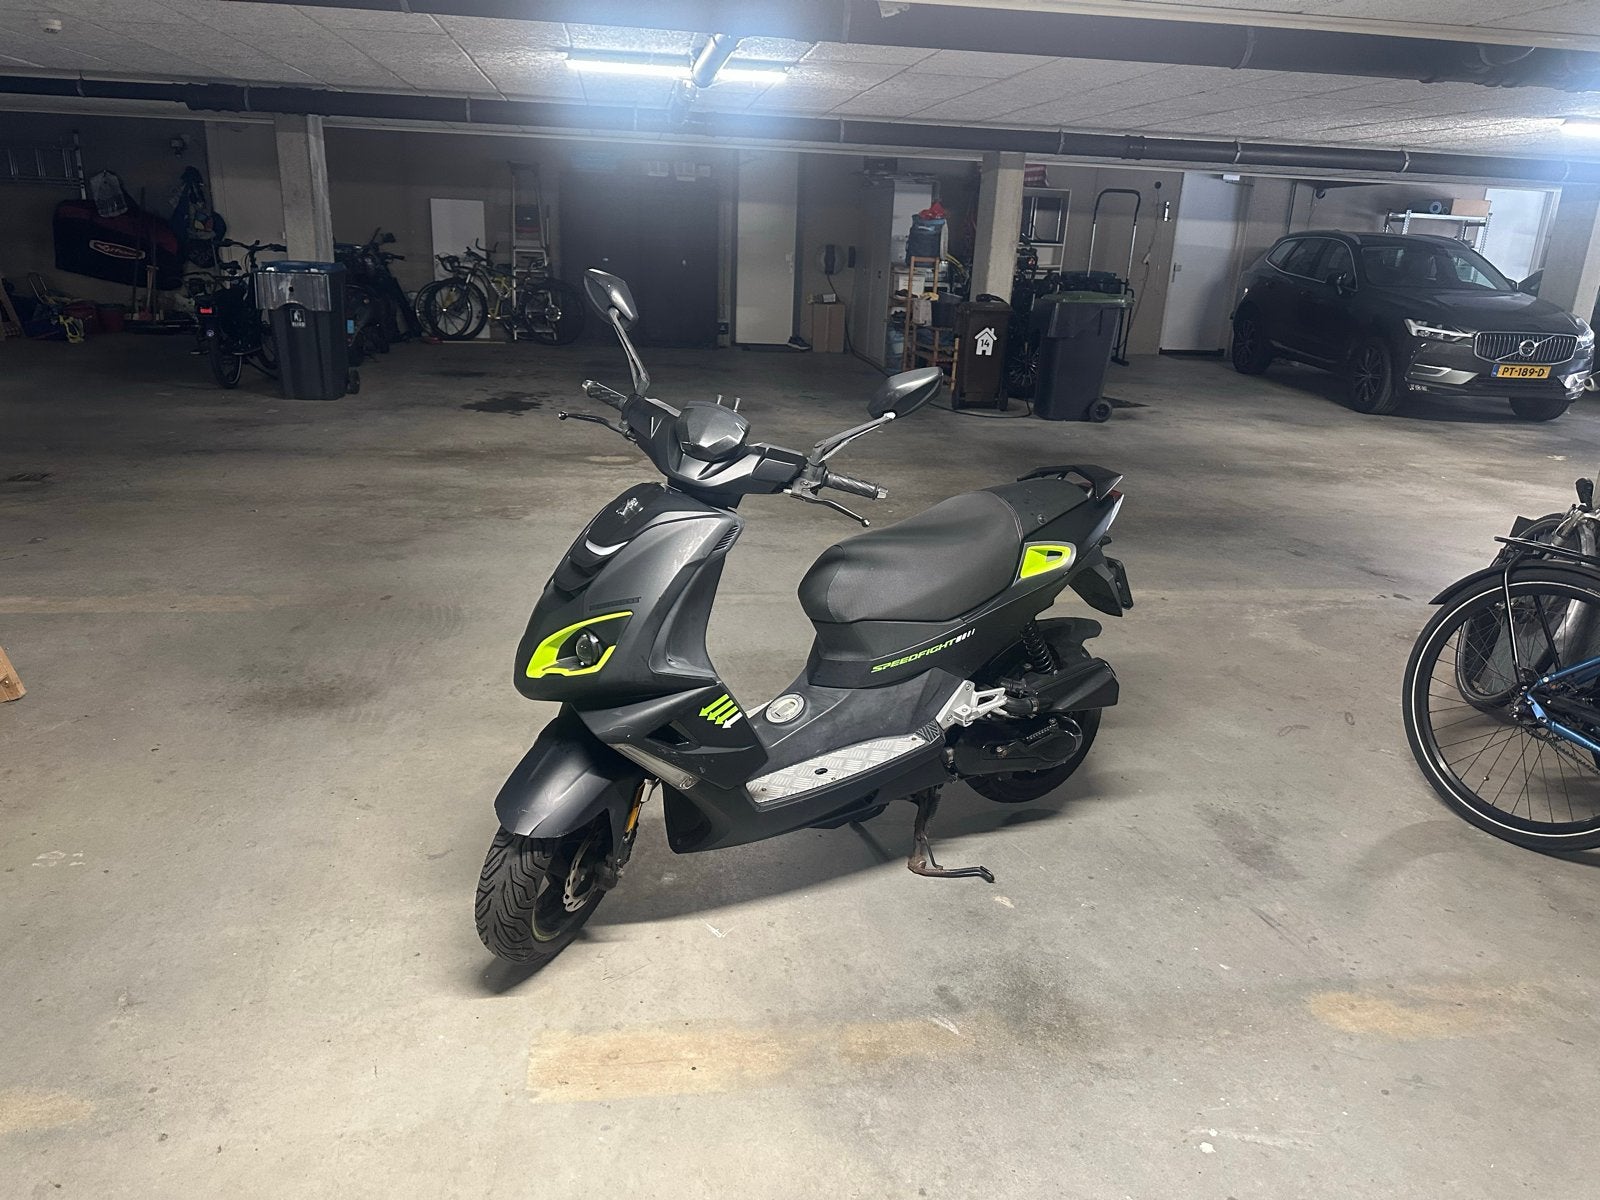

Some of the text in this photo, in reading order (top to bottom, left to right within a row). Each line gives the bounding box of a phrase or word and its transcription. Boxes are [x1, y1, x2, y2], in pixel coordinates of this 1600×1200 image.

[981, 339, 990, 347] 14
[1501, 367, 1545, 377] PT-189-D
[871, 637, 957, 673] SPEEDFIGHT
